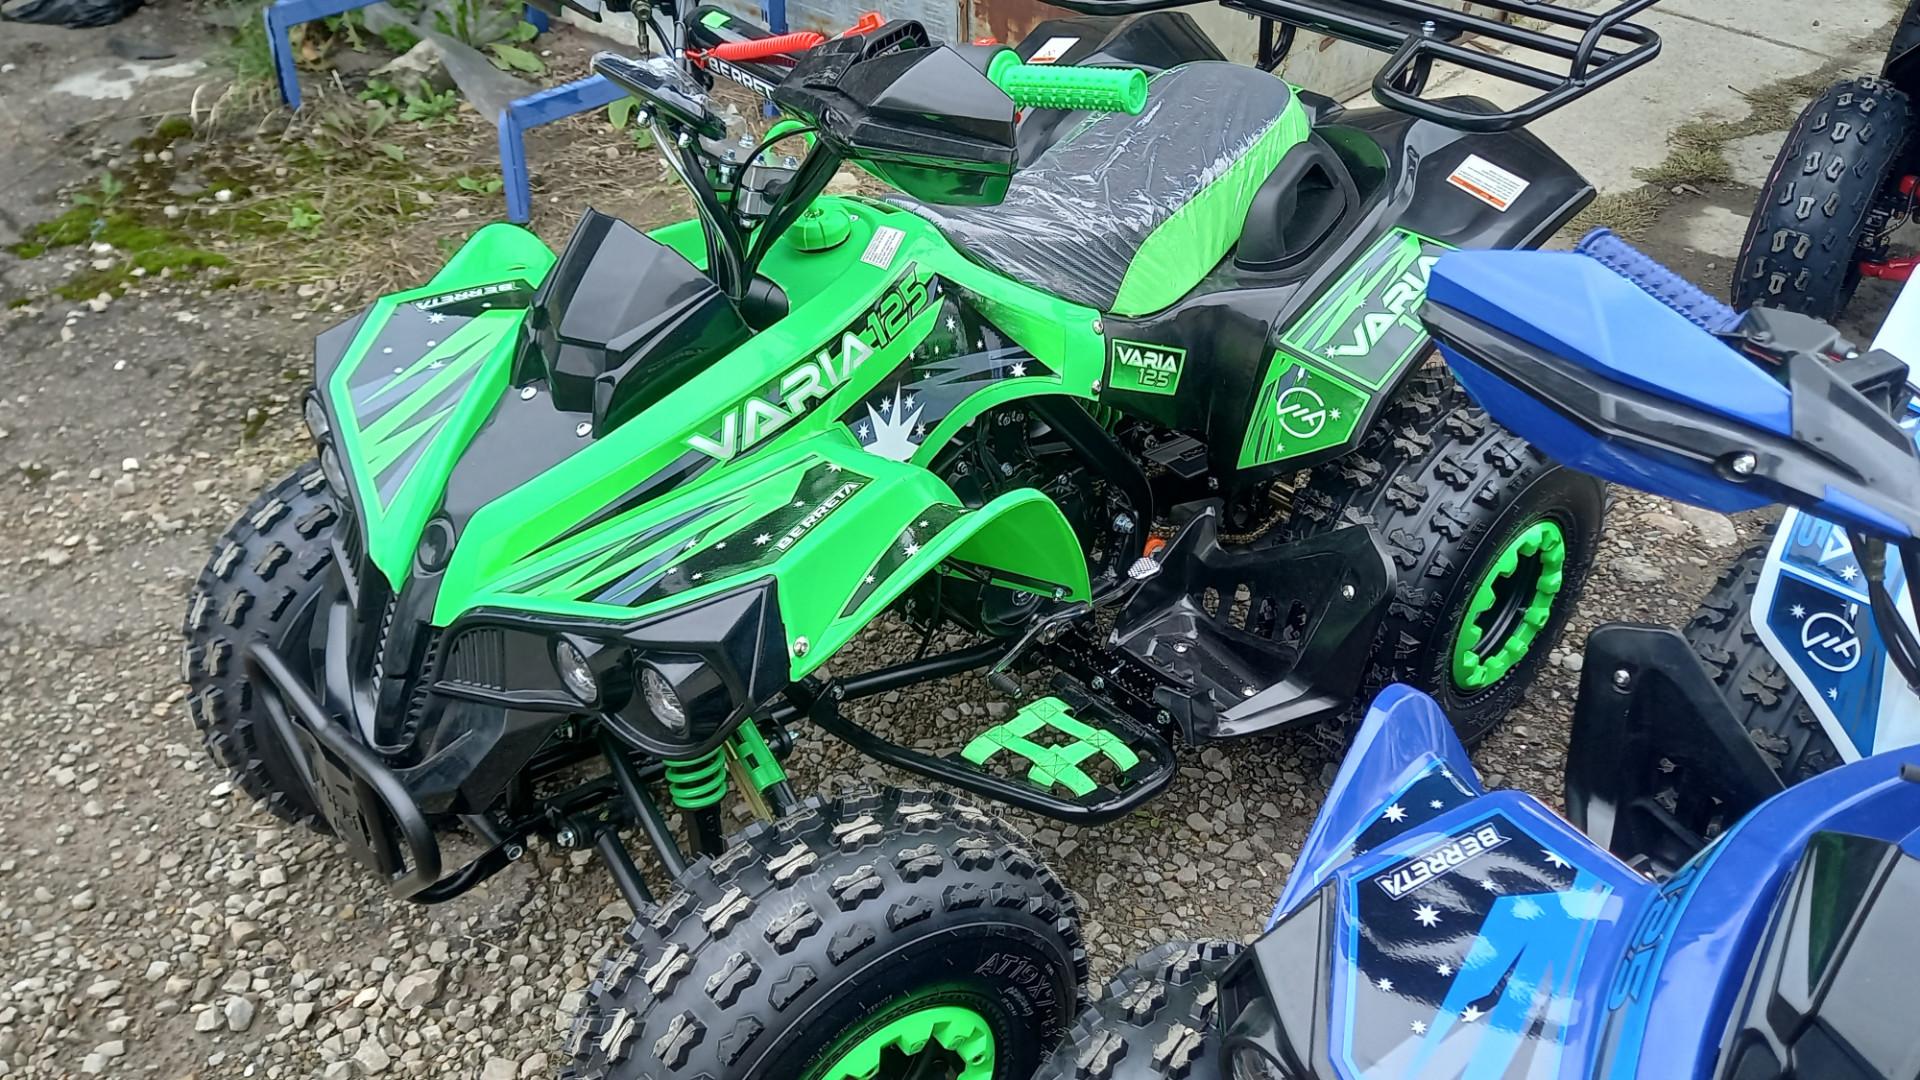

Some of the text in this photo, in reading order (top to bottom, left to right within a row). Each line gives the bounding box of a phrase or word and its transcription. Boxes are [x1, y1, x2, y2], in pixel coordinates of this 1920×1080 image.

[708, 57, 776, 100] BERRET
[416, 283, 513, 310] BERRETA
[1116, 346, 1177, 373] VARIA
[1138, 368, 1170, 388] 125
[688, 332, 874, 460] VARIA
[778, 482, 859, 549] BERRETA
[1380, 827, 1502, 896] BERRETA
